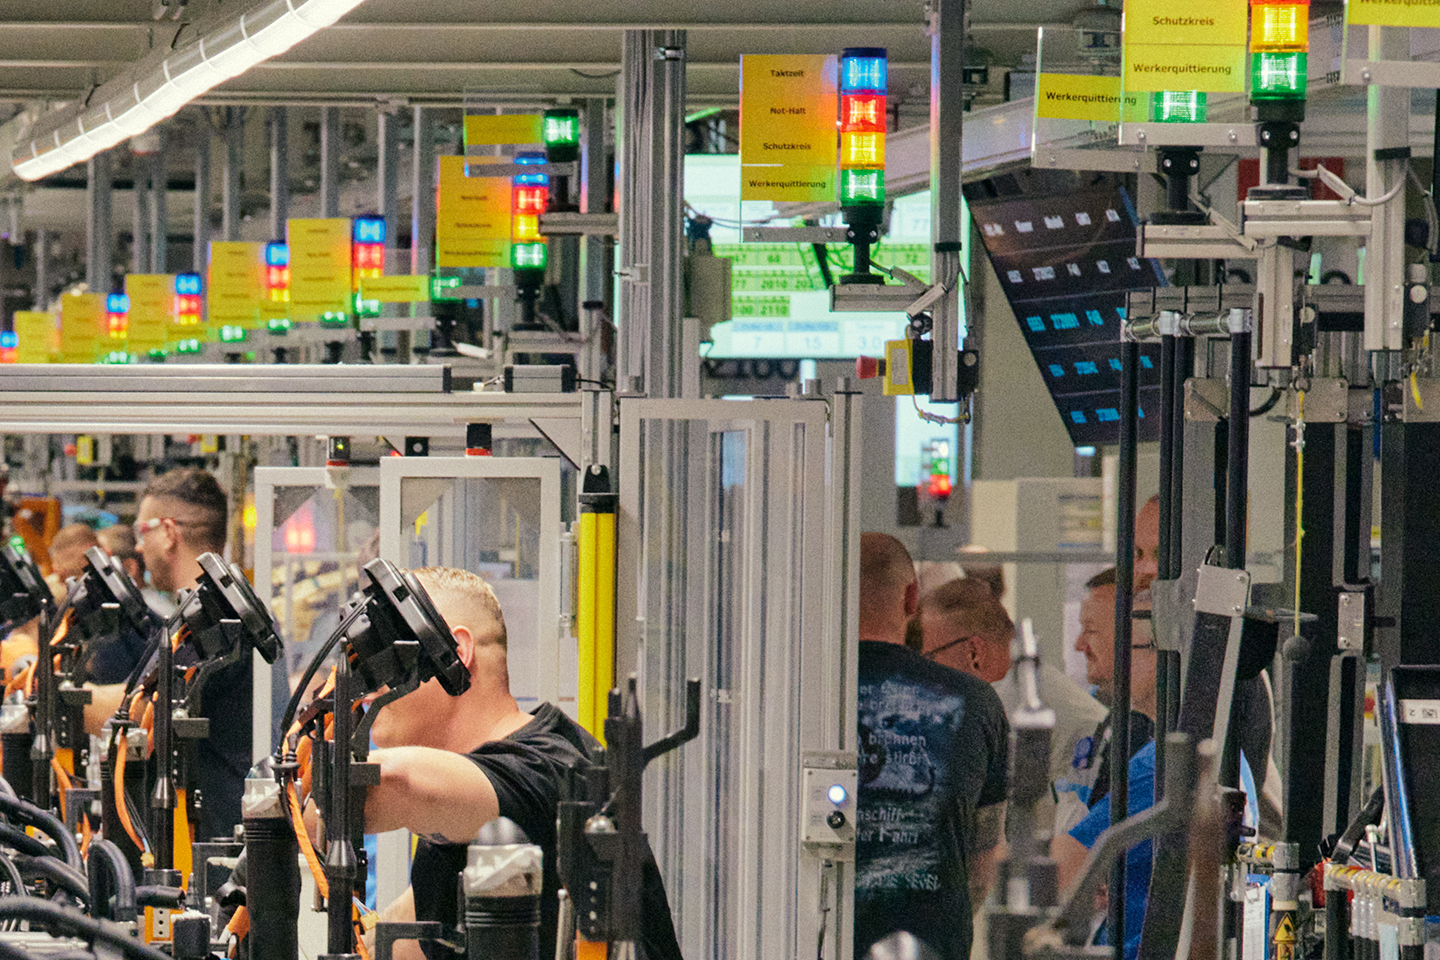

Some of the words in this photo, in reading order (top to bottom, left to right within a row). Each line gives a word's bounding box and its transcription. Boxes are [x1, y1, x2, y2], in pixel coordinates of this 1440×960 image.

[1152, 16, 1215, 26] Schutzkreis
[770, 69, 804, 77] Taktzeit
[1133, 63, 1232, 75] Werkerquittierung
[1046, 91, 1137, 105] Werkerquittierung
[770, 107, 806, 115] Not-Halt
[763, 142, 812, 150] Schutzkreis
[749, 180, 826, 189] Werkerquittierung
